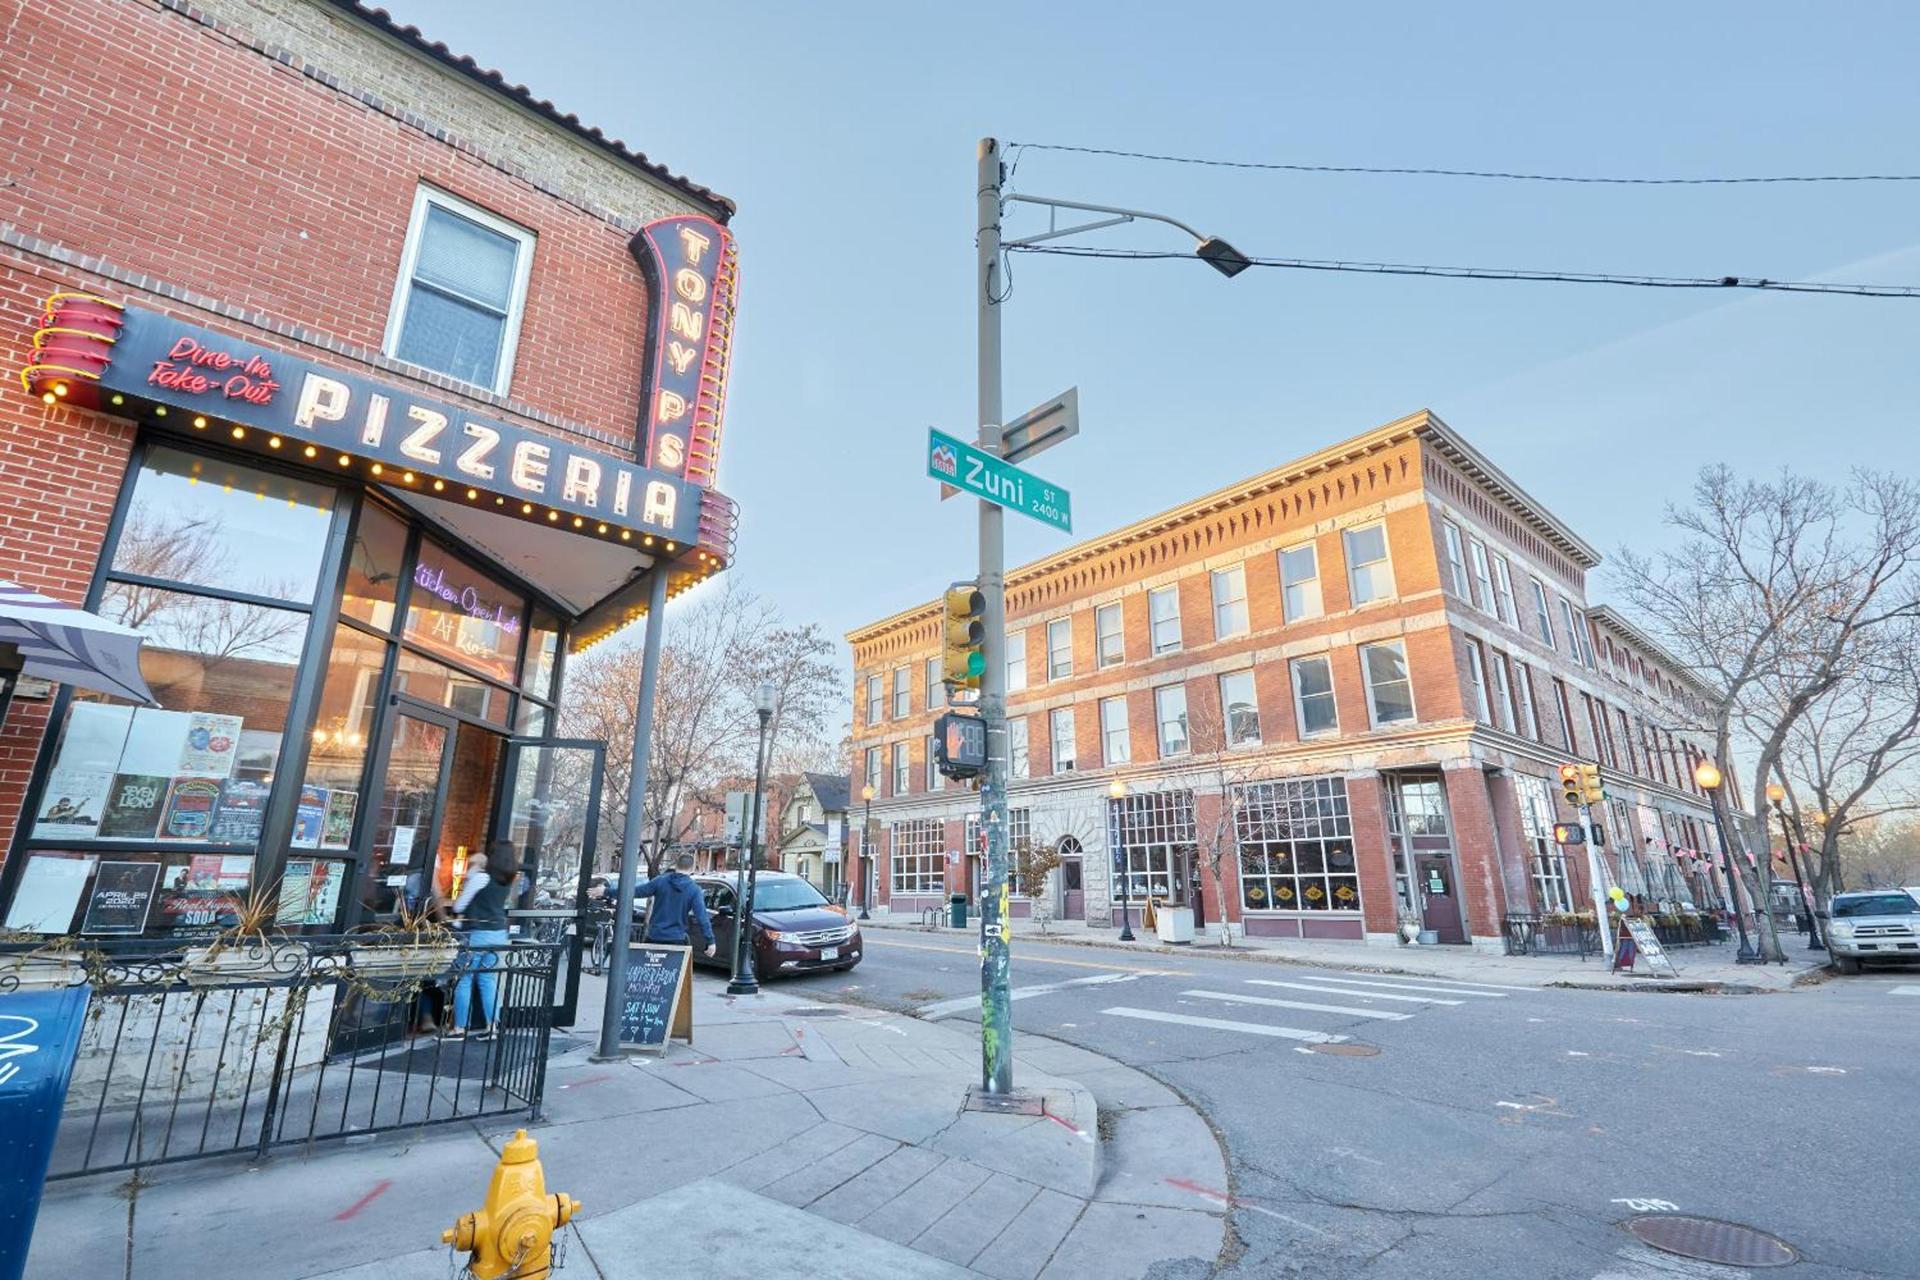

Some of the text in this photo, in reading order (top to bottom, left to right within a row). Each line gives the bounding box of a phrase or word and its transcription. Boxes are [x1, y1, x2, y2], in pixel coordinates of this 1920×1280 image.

[668, 227, 711, 375] TONY
[168, 336, 273, 379] Dine-In
[147, 360, 280, 405] Take-Out
[294, 371, 678, 530] PIZZERIA
[965, 455, 1024, 506] Zuni
[1043, 488, 1056, 504] ST
[1032, 499, 1059, 521] 2400
[462, 586, 493, 622] Open
[96, 891, 148, 900] APRIL 25
[105, 897, 136, 905] 2020
[185, 910, 217, 925] SODA
